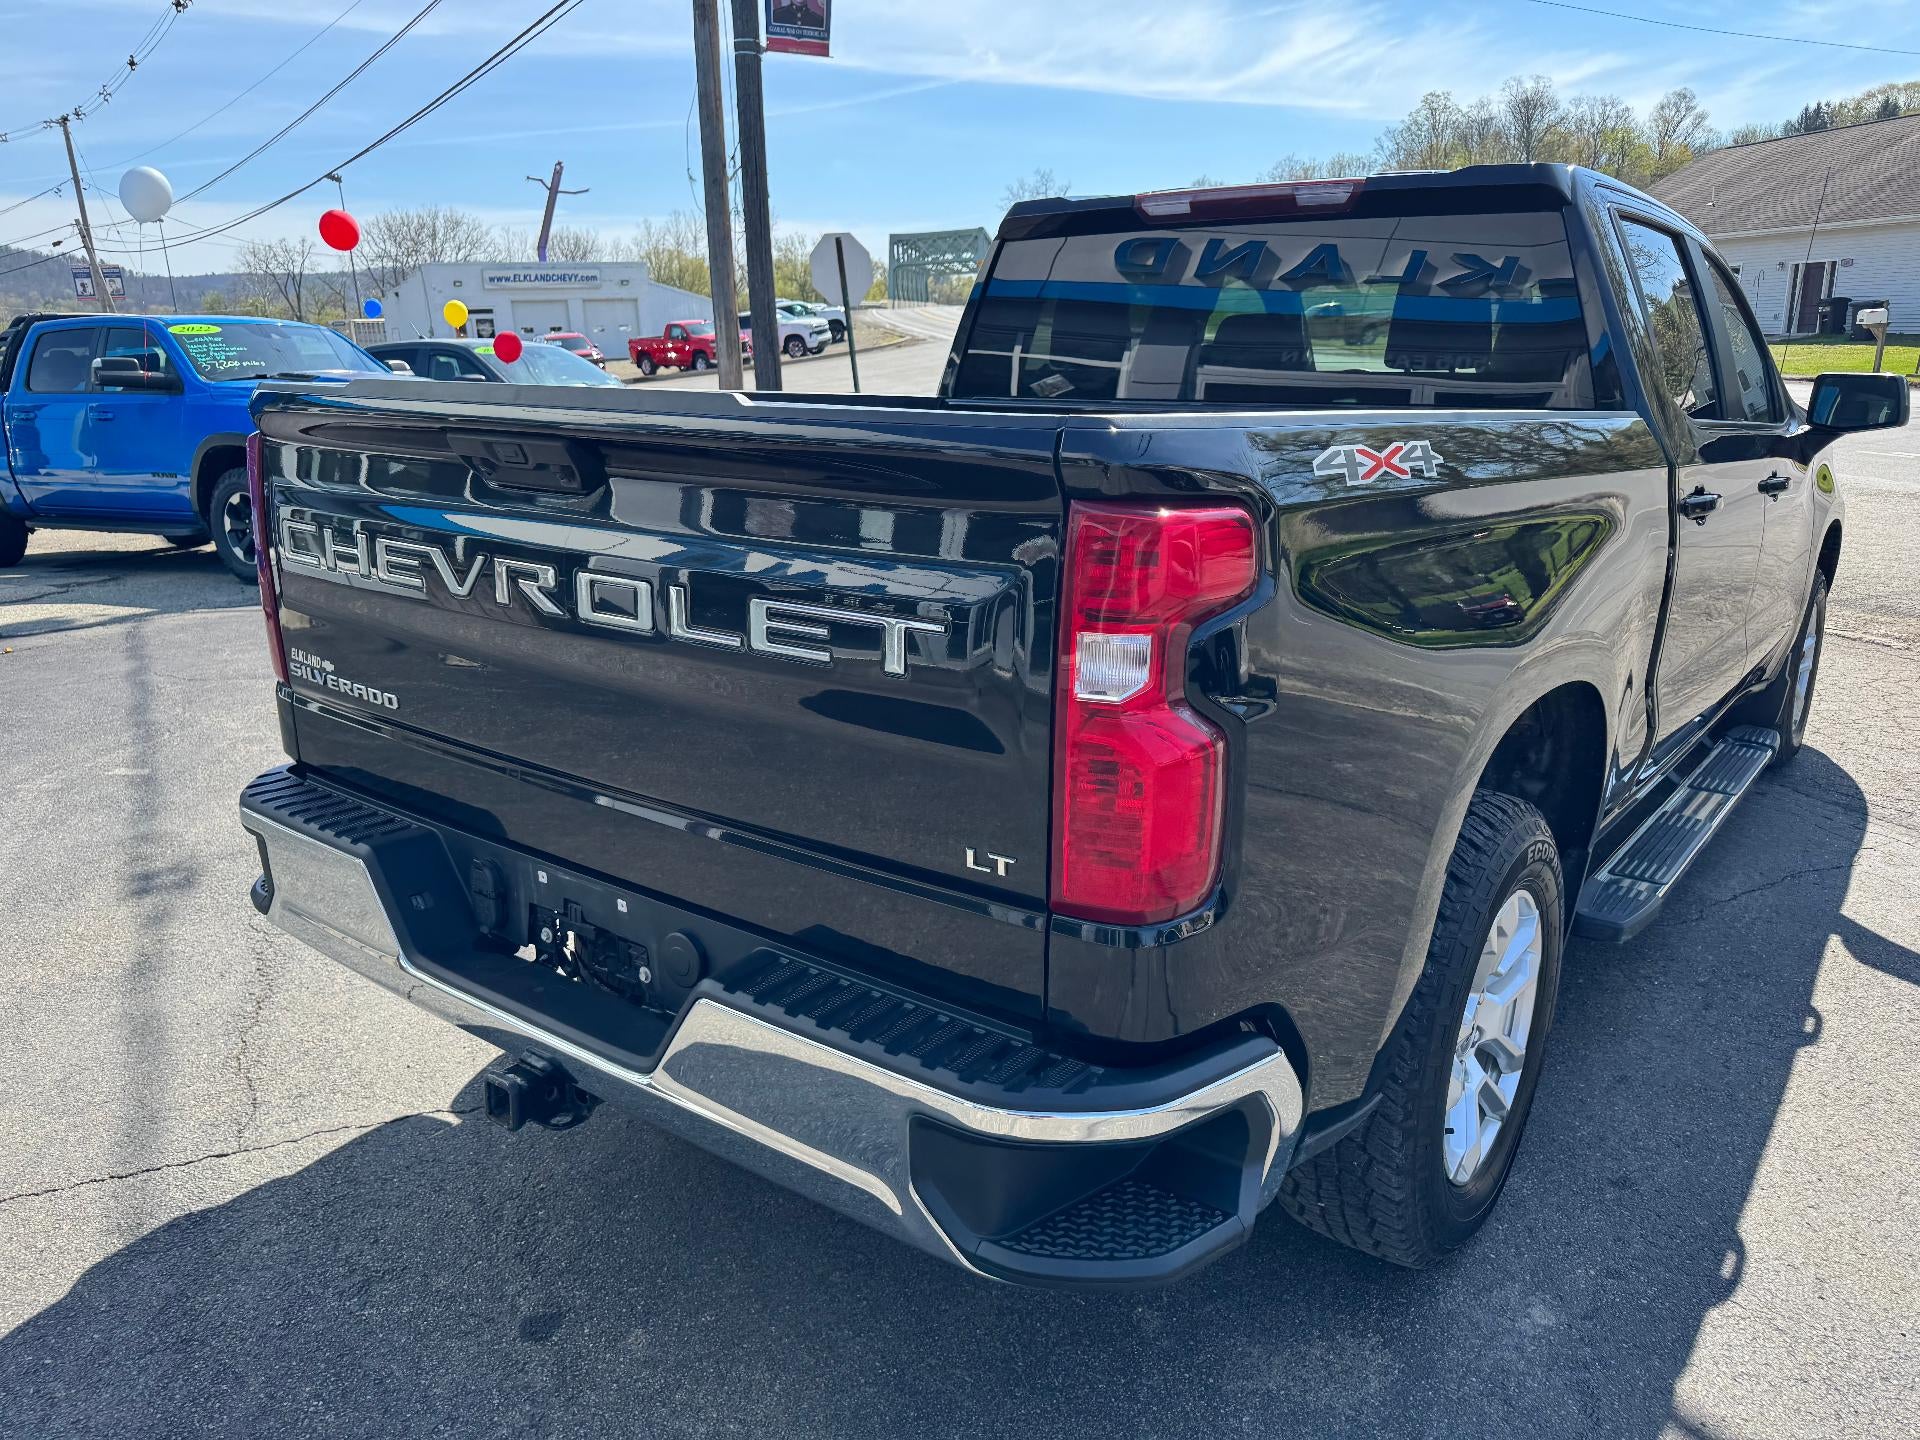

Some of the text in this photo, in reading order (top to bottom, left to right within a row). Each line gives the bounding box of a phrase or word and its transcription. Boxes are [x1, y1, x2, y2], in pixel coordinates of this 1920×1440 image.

[488, 273, 598, 283] www.ELKLANDCHEVY.com
[282, 519, 951, 677] CHEVROLET
[291, 647, 322, 669] ELKLAND
[290, 662, 399, 710] SILVERADO
[965, 847, 1017, 877] LT
